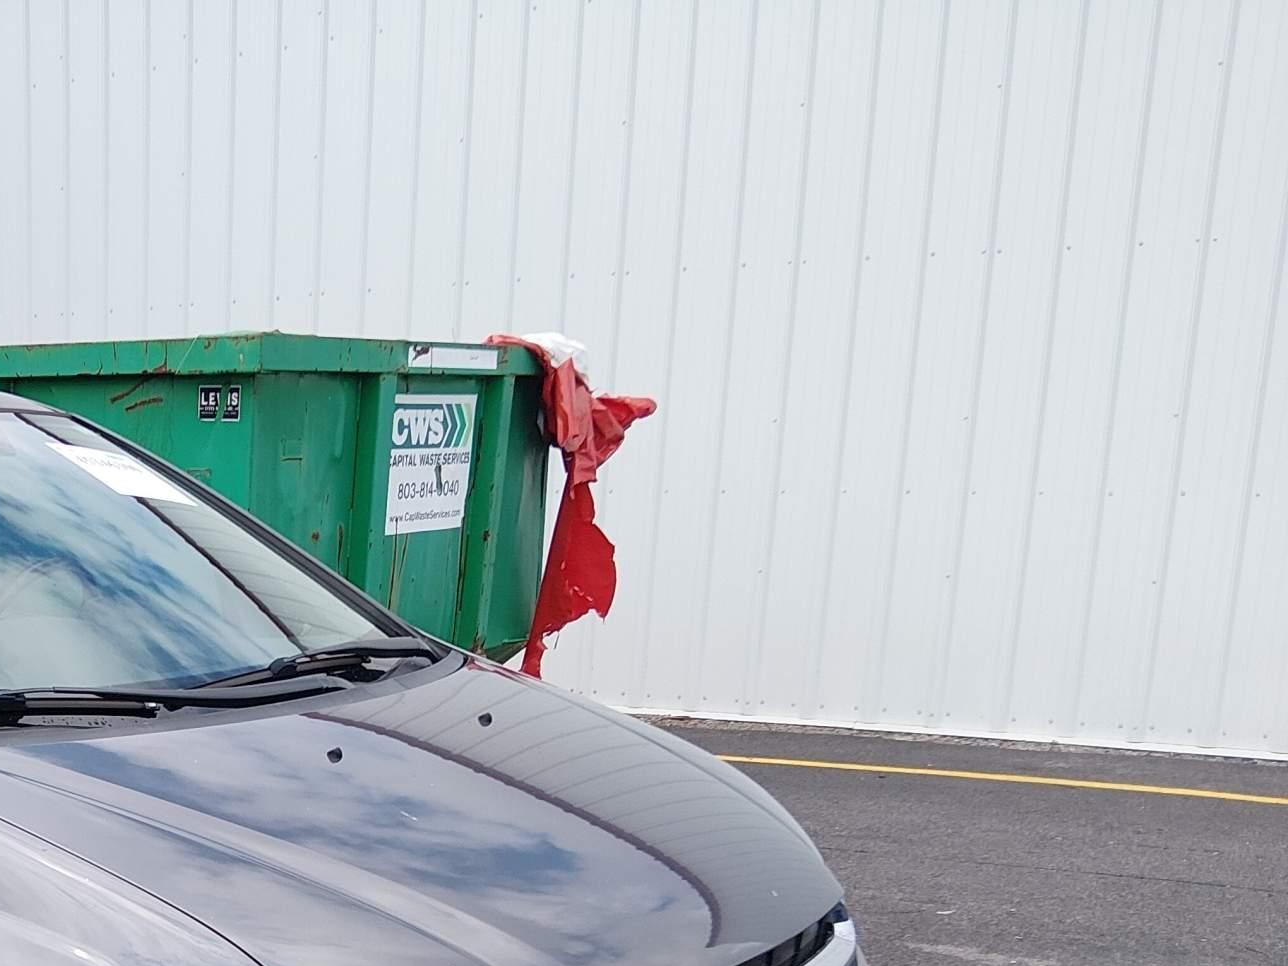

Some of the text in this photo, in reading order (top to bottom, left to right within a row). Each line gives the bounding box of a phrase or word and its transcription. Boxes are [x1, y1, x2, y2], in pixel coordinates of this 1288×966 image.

[392, 408, 444, 446] CWS
[390, 451, 470, 467] APITAL WASTE SERVICES
